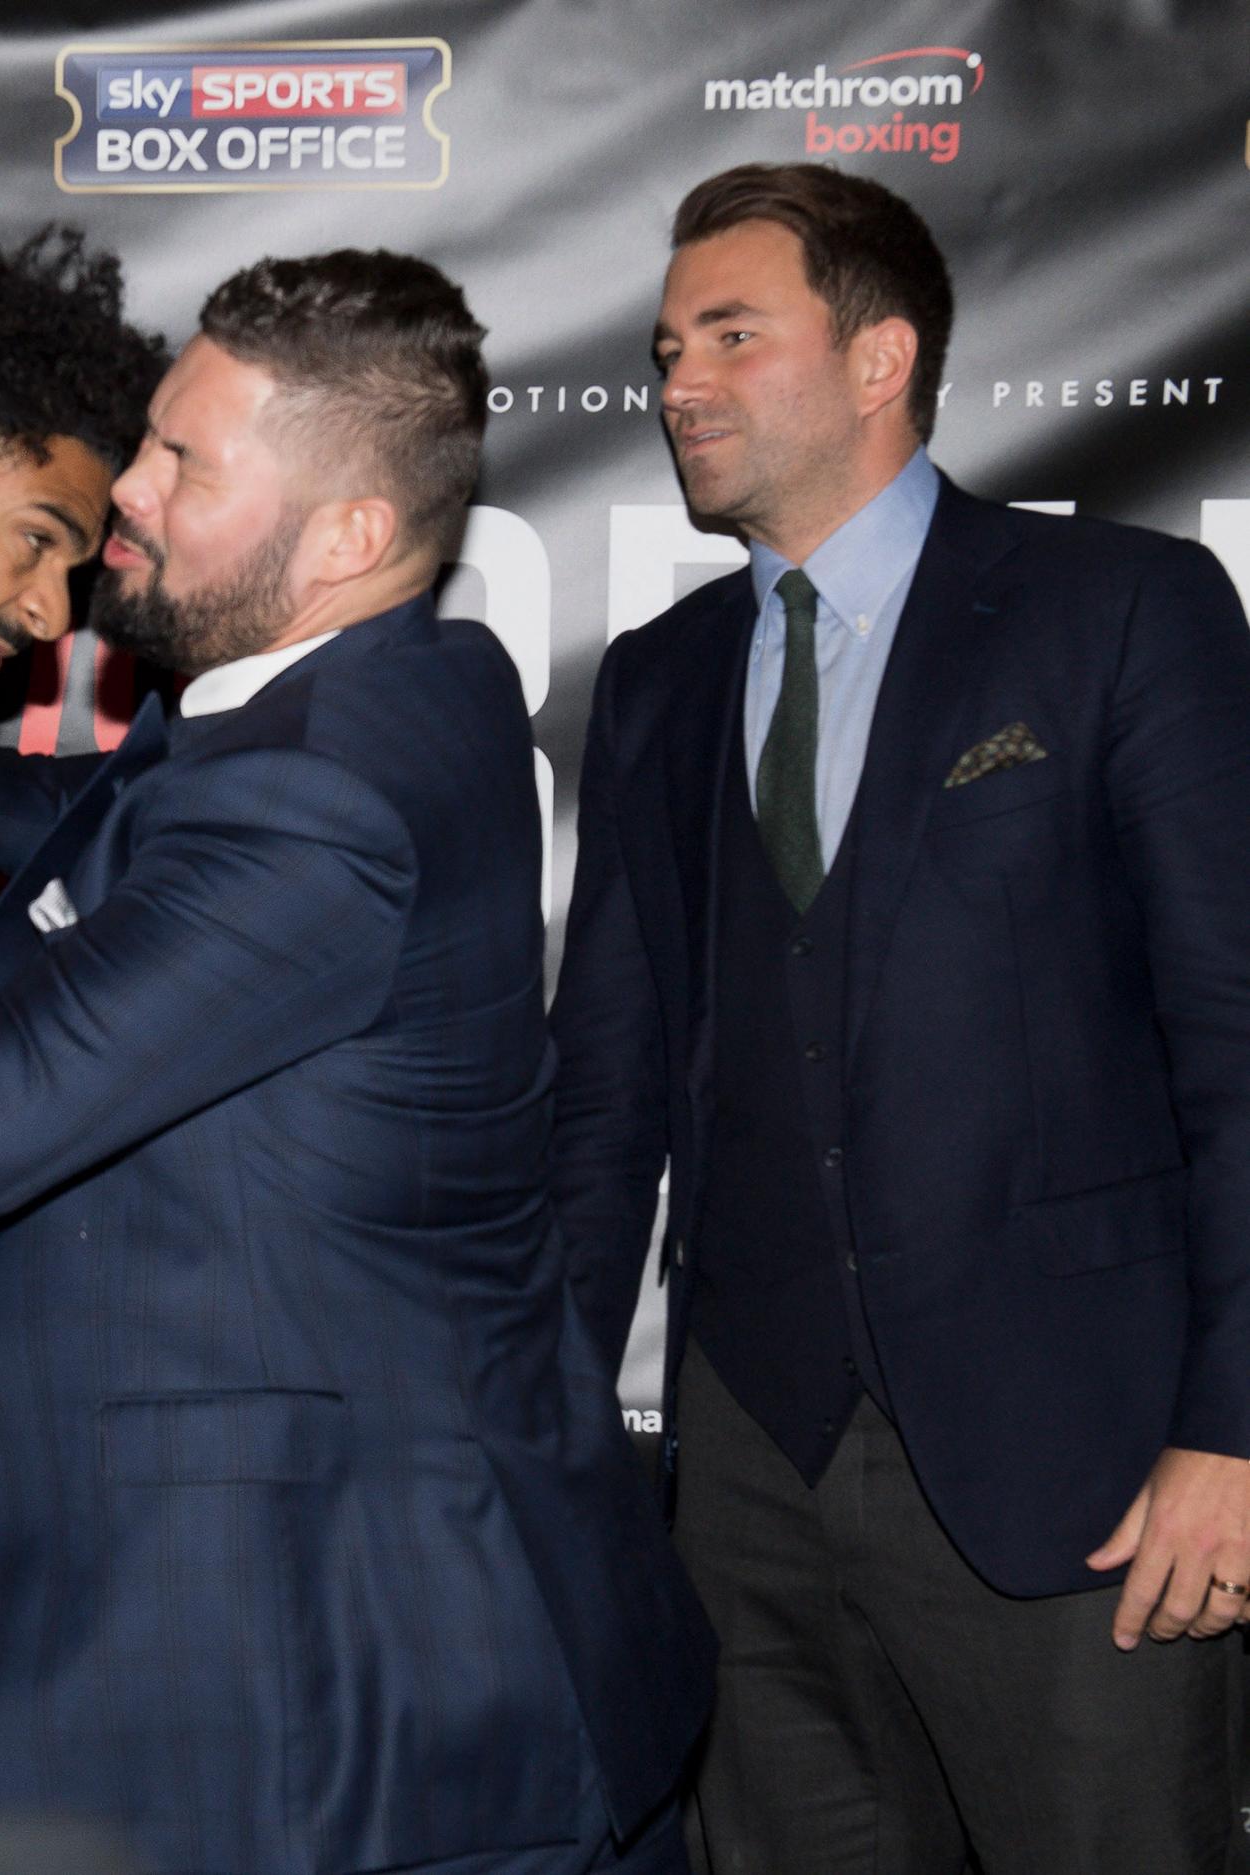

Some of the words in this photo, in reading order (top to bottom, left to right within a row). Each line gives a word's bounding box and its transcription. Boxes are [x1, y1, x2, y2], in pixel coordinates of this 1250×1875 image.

[108, 69, 183, 118] sky
[201, 70, 396, 111] SPORTS
[704, 64, 963, 110] matchroom
[97, 127, 208, 172] BOX
[216, 126, 406, 170] OFFICE
[805, 111, 961, 163] boxing
[993, 378, 1223, 408] PRESENT
